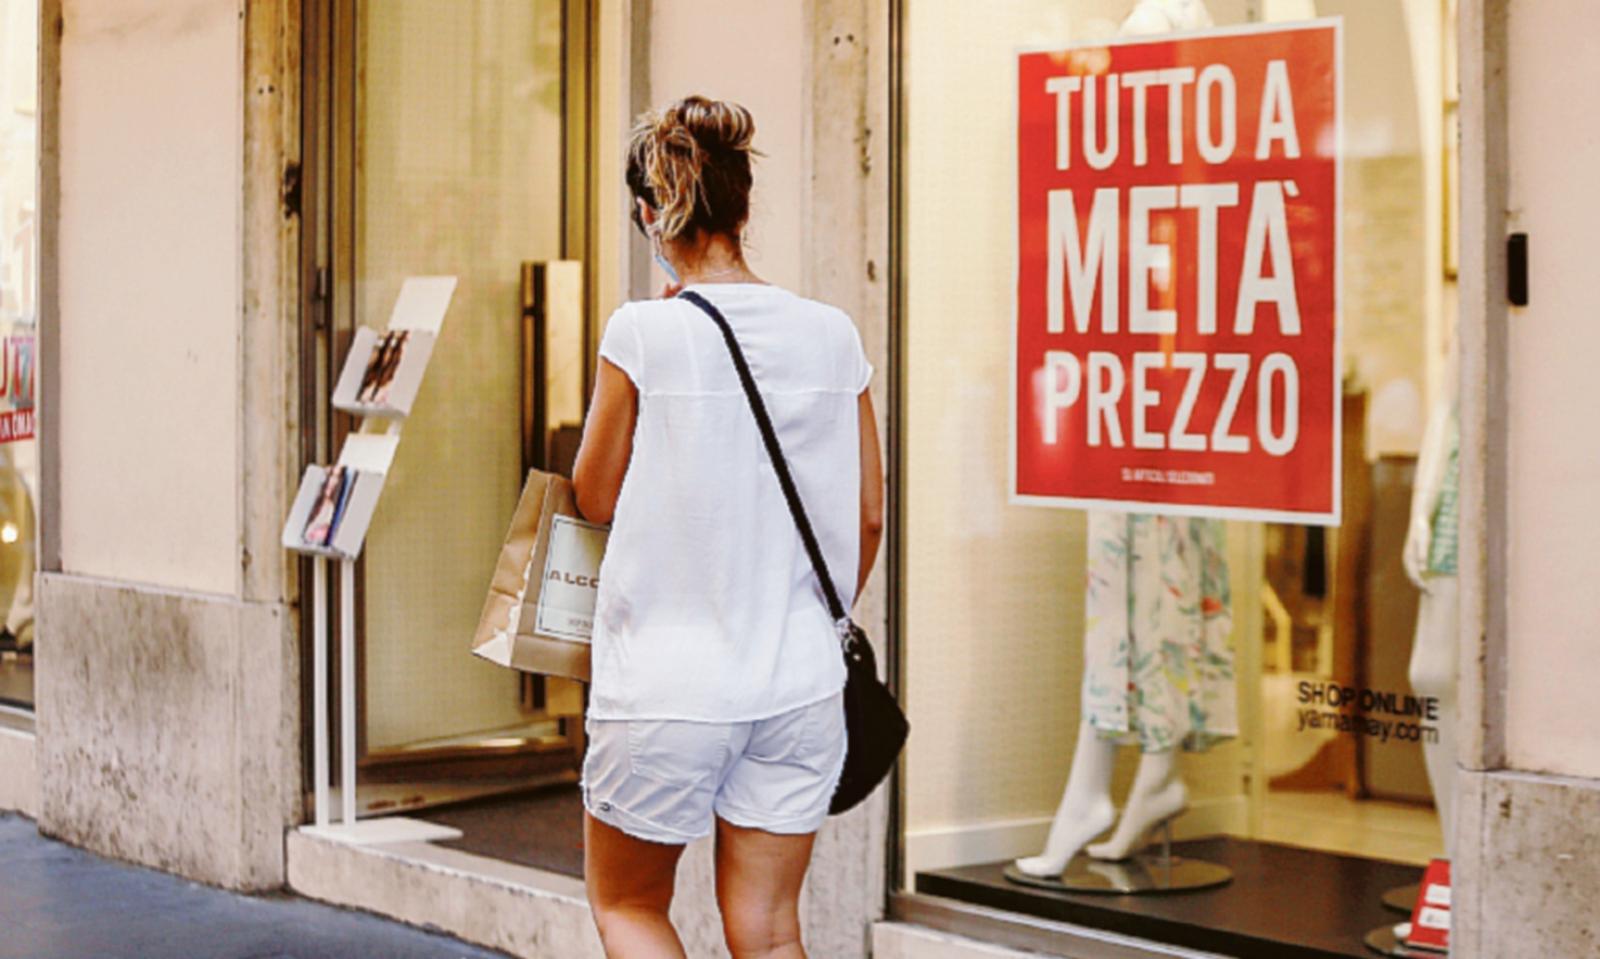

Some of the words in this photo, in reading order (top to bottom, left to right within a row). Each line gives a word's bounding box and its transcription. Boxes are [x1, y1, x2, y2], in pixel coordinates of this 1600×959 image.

[1045, 64, 1237, 170] TUTTO
[1256, 60, 1300, 160] A
[1047, 180, 1301, 335] METÀ
[1042, 351, 1299, 456] PREZZO
[1297, 681, 1355, 708] SHOP
[1358, 688, 1439, 720] ONLINE
